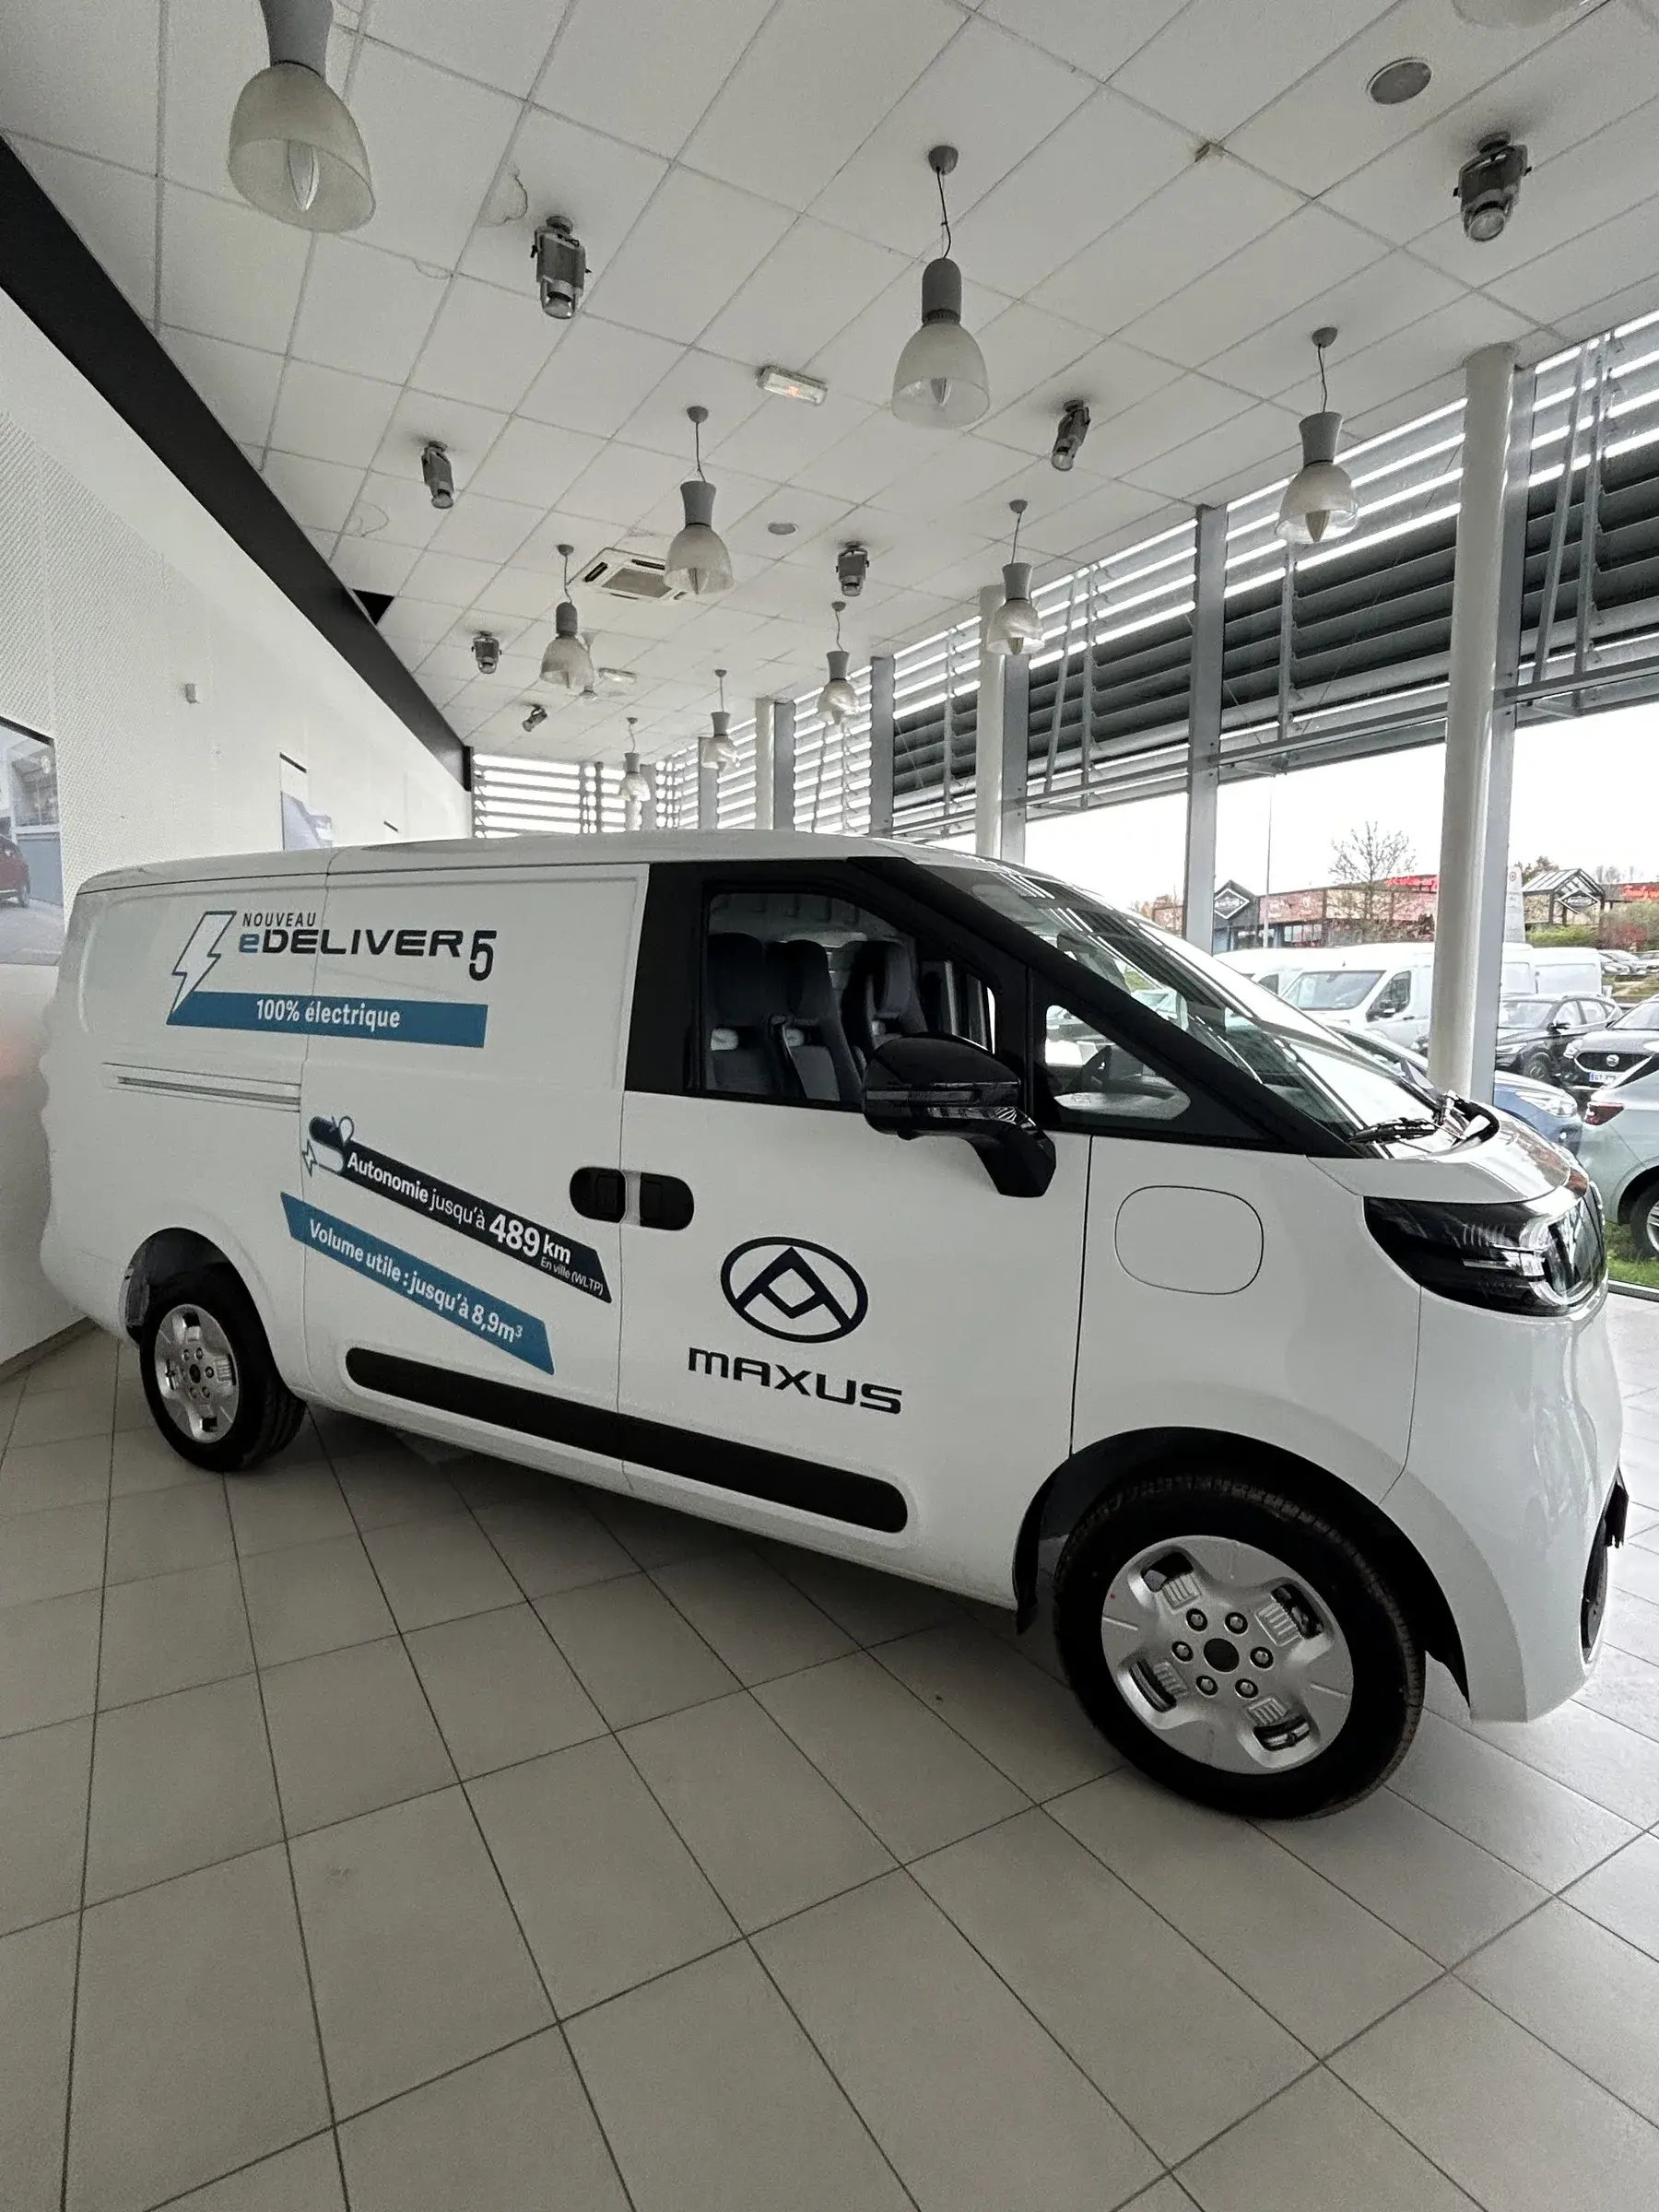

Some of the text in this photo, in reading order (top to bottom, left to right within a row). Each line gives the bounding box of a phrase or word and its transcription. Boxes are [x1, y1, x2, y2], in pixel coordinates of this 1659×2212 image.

[242, 912, 316, 927] NOUVEAU
[256, 999, 401, 1032] 100% électrique
[347, 1152, 571, 1265] Autonomie jusqu'à 489 km
[310, 1218, 364, 1263] Volume
[365, 1252, 401, 1282] utile
[406, 1270, 469, 1320] jusqu'à
[540, 1256, 604, 1296] En ville (WLTP)
[688, 1347, 902, 1415] MAXUS
